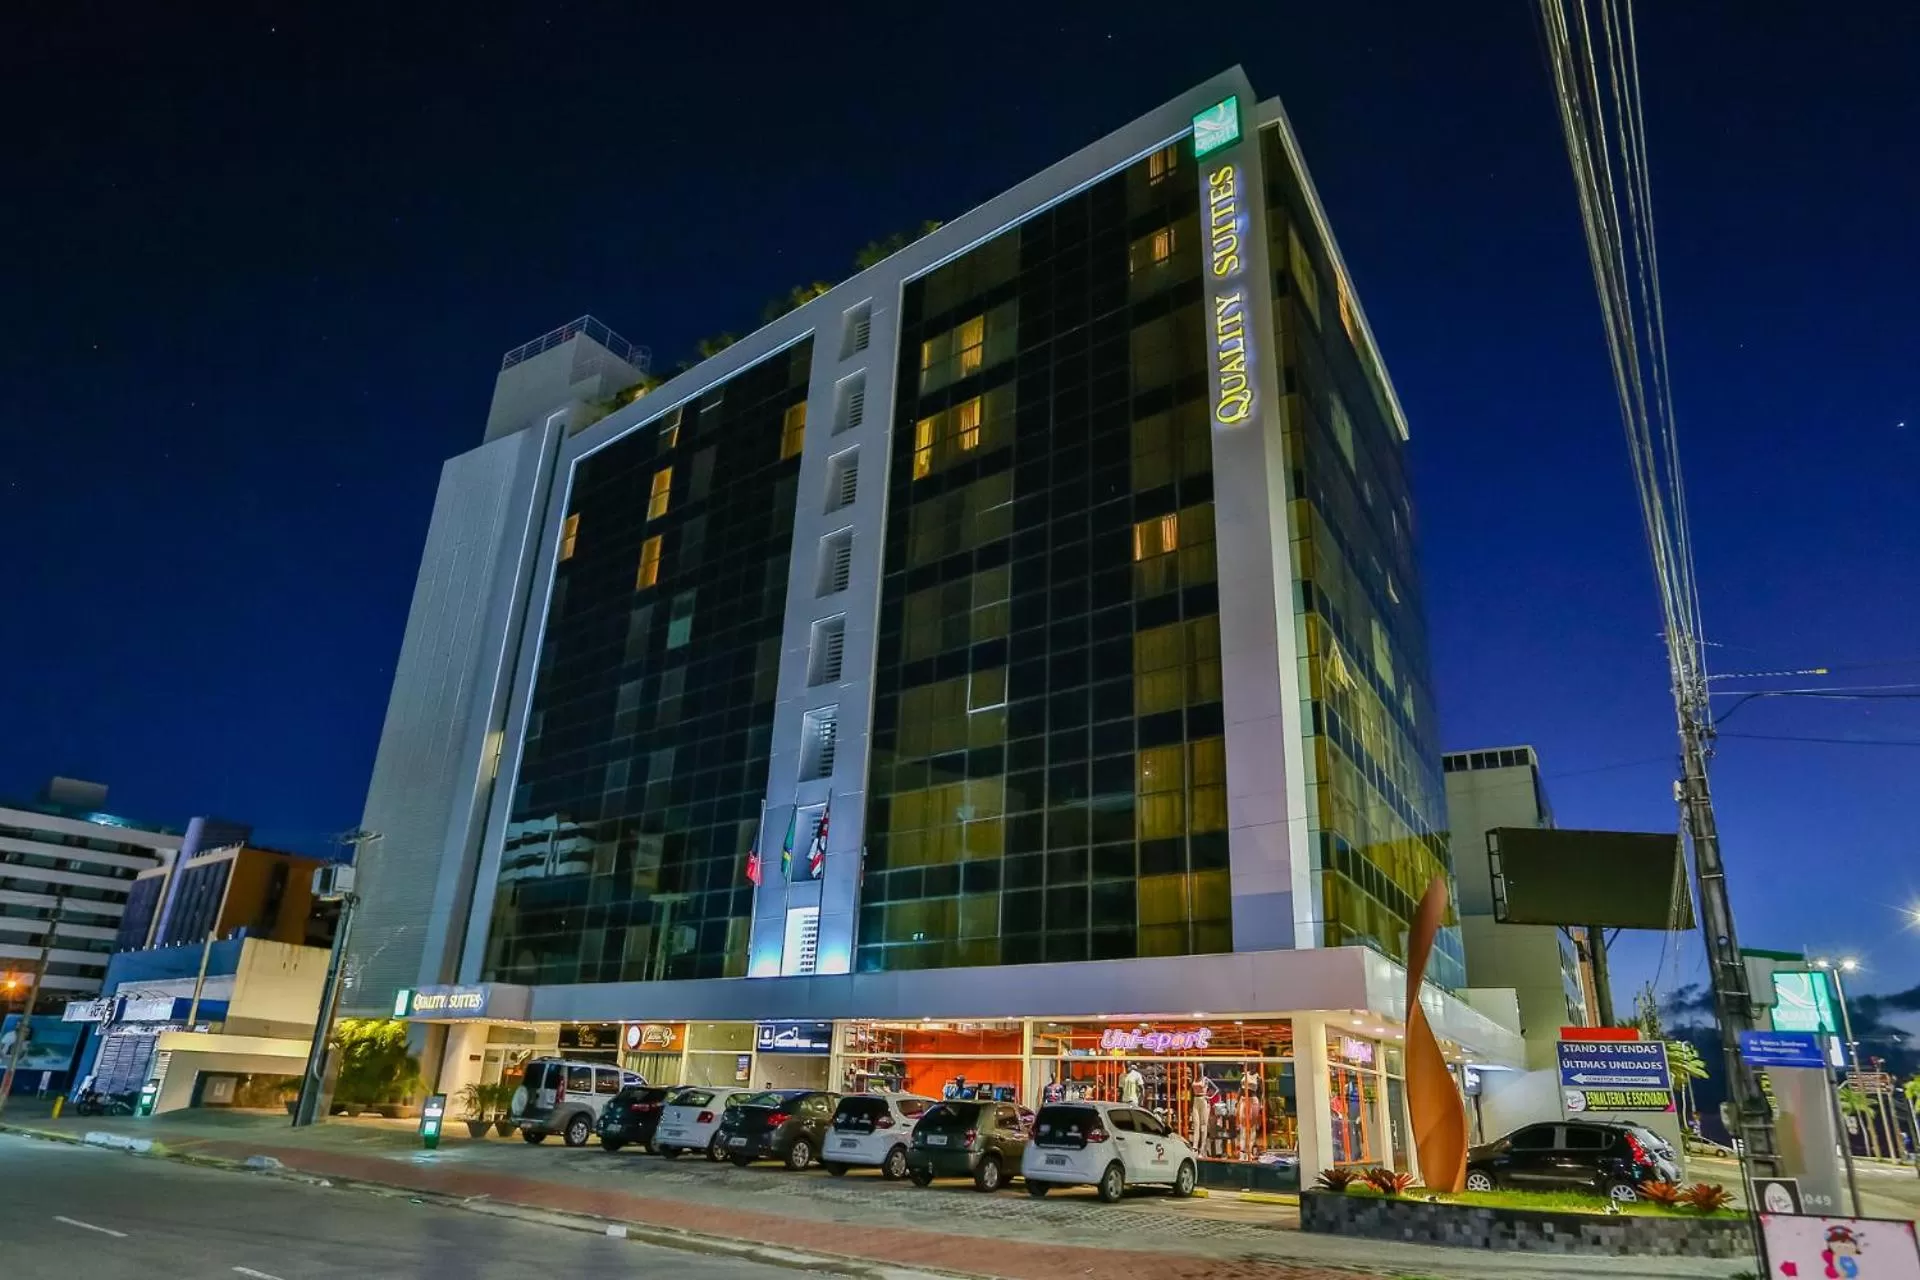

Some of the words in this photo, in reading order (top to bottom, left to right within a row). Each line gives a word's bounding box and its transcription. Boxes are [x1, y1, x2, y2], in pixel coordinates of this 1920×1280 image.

[1210, 164, 1240, 280] SUITES
[1215, 292, 1254, 426] QUALITY
[413, 993, 446, 1011] QUALITY
[448, 993, 482, 1009] SUITES
[1101, 1028, 1211, 1053] Uni-sport
[1563, 1044, 1597, 1053] STAND
[1599, 1045, 1613, 1053] DE
[1614, 1045, 1658, 1054] VENDAS
[1562, 1058, 1607, 1069] ÚLTIMAS
[1608, 1060, 1663, 1070] UNIDADES
[1586, 1091, 1626, 1105] ESMALTERIA
[1626, 1092, 1632, 1105] E
